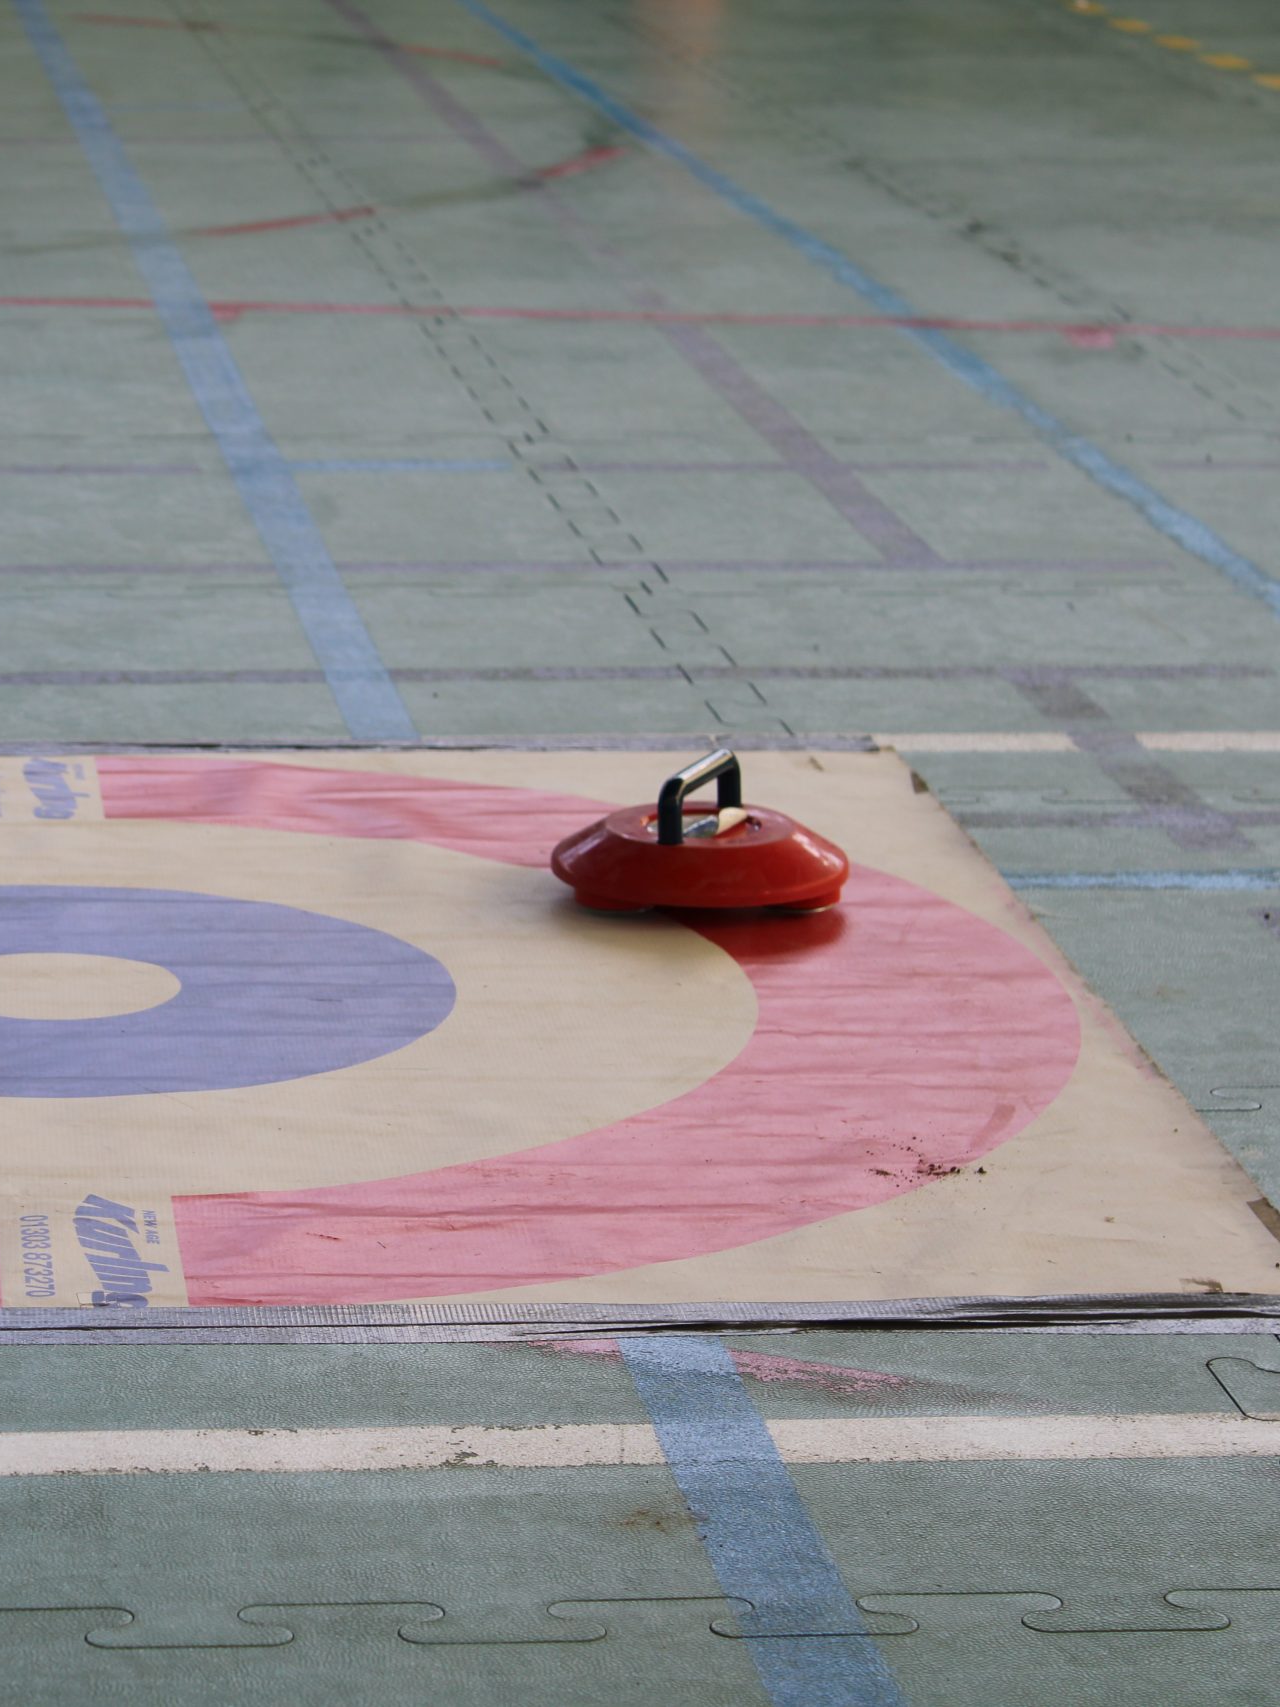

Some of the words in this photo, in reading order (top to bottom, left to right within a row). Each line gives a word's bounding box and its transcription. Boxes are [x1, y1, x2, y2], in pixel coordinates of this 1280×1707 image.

[19, 1214, 52, 1249] 01303
[141, 1209, 158, 1229] NEW
[145, 1229, 161, 1245] AGE
[23, 1252, 56, 1298] 873270
